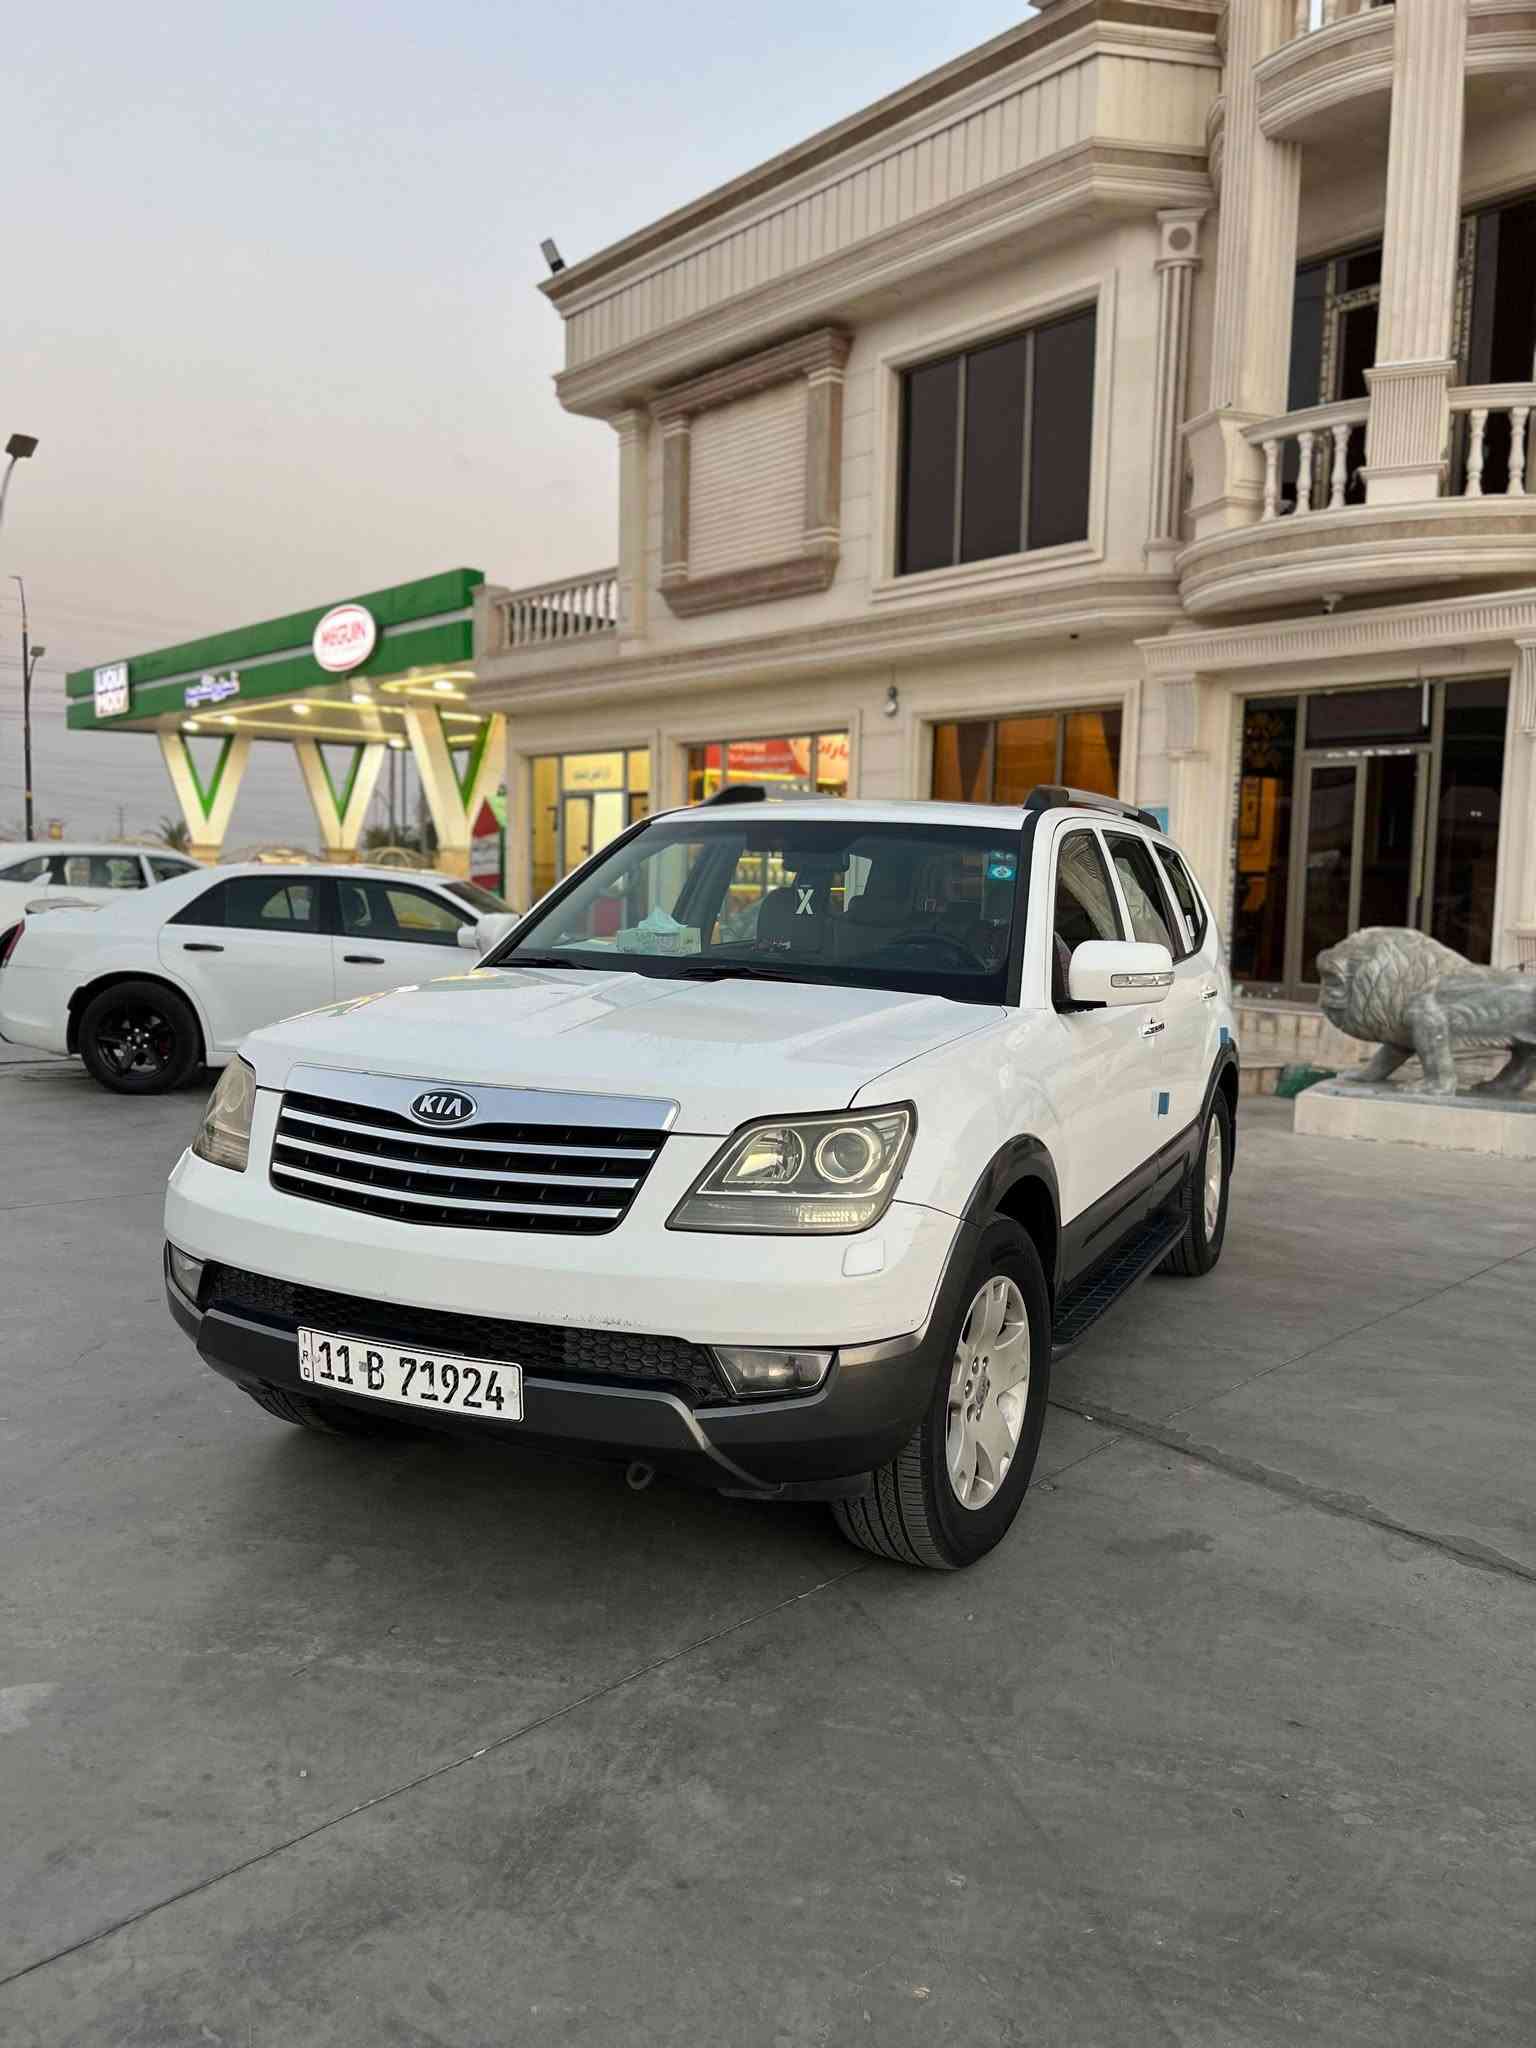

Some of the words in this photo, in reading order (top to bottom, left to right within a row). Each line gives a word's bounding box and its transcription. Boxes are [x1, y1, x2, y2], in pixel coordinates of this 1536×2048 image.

[418, 1095, 462, 1117] KIA
[318, 1341, 354, 1385] 11
[366, 1350, 385, 1390] B
[399, 1356, 505, 1411] 71924
